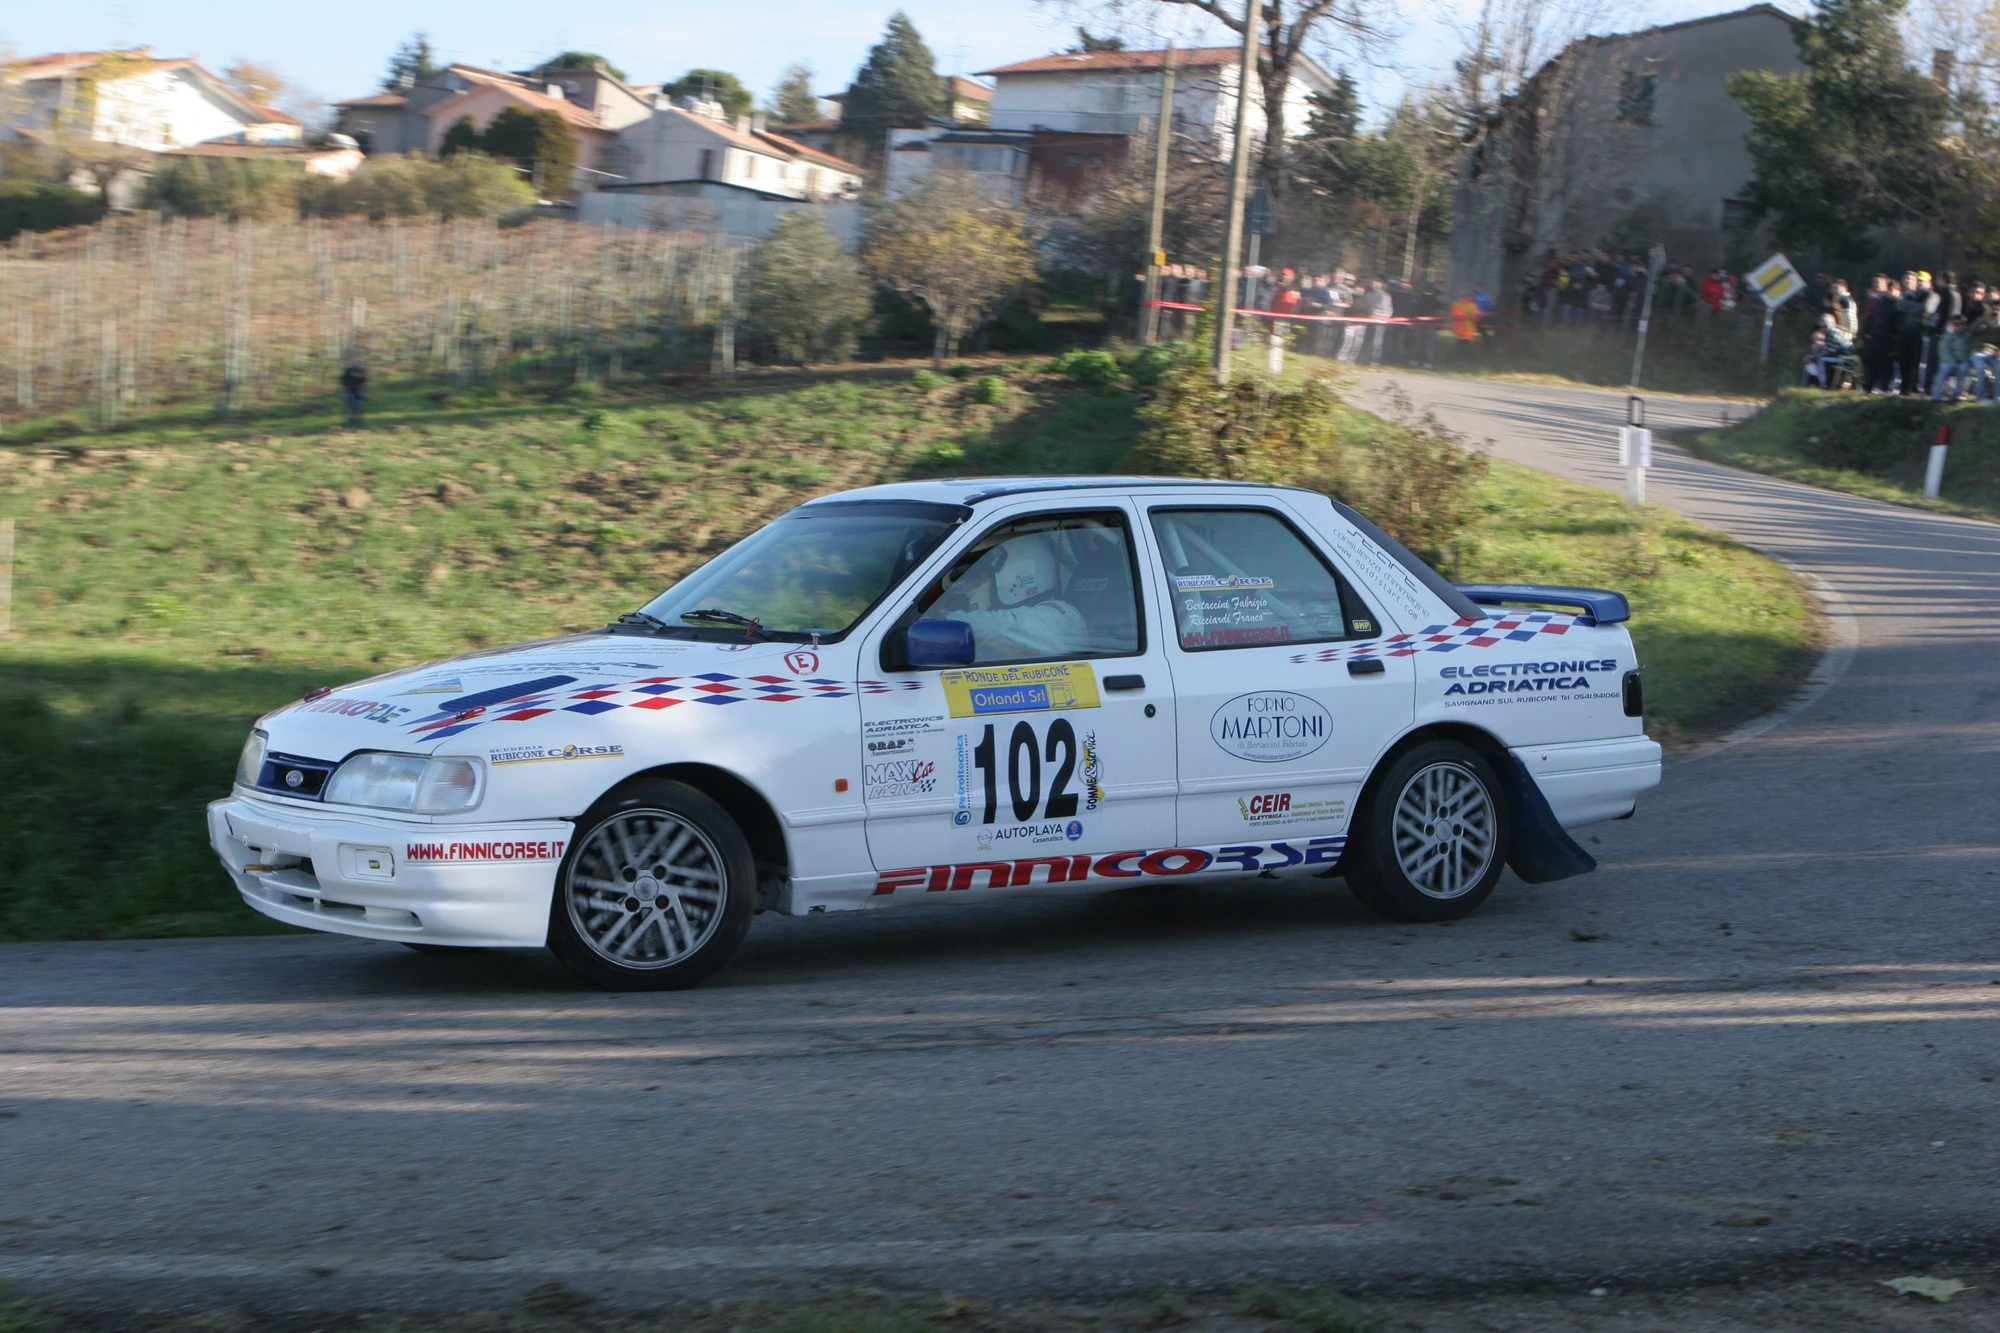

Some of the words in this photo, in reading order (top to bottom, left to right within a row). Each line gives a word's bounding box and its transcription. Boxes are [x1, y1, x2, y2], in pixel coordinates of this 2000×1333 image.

[1333, 528, 1381, 573] consulenza
[1177, 579, 1217, 588] RUBICONE
[1336, 543, 1419, 620] www.noidistart.com
[1184, 599, 1230, 611] Bertaccini
[1231, 596, 1268, 611] Fabrizio
[1189, 614, 1231, 626] Ricciardi
[1232, 612, 1264, 625] Franco
[963, 670, 1000, 683] RONDE
[1002, 670, 1021, 682] DEL
[1023, 664, 1071, 680] RUBICONE
[1439, 658, 1618, 680] ELECTRONICS
[1443, 676, 1591, 696] ADRIATICA
[974, 690, 1025, 706] Orlandi
[1028, 689, 1046, 703] Srl
[1247, 697, 1296, 712] FORNO
[1444, 698, 1495, 708] SAVIGNANO
[1497, 697, 1514, 705] SUL
[1516, 694, 1558, 703] RUBICONE
[864, 715, 945, 727] ELECTRONICS
[865, 723, 930, 733] ADRIATICA
[1221, 715, 1324, 739] MARTONI
[489, 745, 543, 753] SCUDERIA
[1237, 740, 1245, 749] di
[1247, 740, 1280, 749] Bertaccini
[490, 749, 545, 761] RUBICONE
[865, 759, 919, 786] MAXI
[955, 734, 967, 809] Petroltecnica
[974, 718, 1079, 825] 102
[868, 781, 921, 799] RACING
[1250, 793, 1292, 814] CEIR
[1249, 813, 1282, 821] ELETTRICA
[995, 823, 1064, 841] AUTOPLAYA
[1032, 836, 1064, 844] Cesenatico
[407, 841, 565, 860] WWW.FINNICORSE.IT
